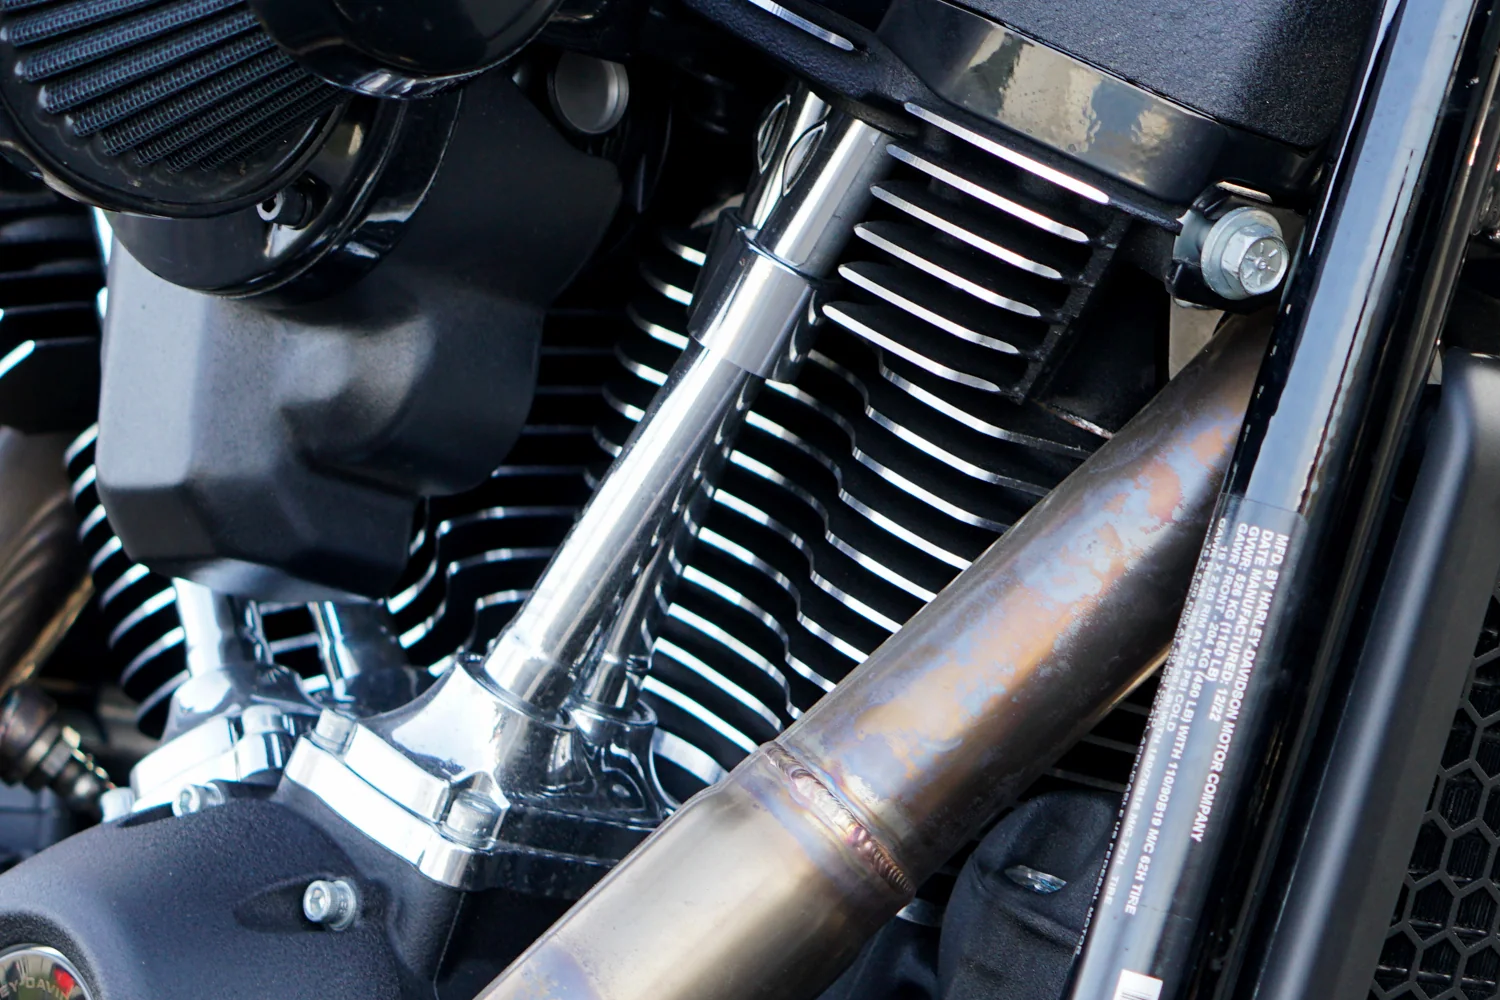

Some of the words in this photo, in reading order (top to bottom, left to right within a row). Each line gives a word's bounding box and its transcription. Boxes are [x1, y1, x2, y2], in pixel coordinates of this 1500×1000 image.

[1216, 544, 1228, 560] 19
[1228, 521, 1248, 565] GAWR
[1237, 524, 1260, 572] GVWR:
[1253, 528, 1274, 567] DATE
[1268, 533, 1289, 568] MFD.
[1213, 562, 1223, 572] X
[1262, 568, 1278, 589] BY
[1214, 566, 1236, 613] FRONT
[1230, 573, 1246, 598] 526
[1196, 603, 1211, 628] RIM
[1223, 598, 1239, 620] KG
[1190, 630, 1203, 649] AT
[1204, 621, 1219, 645] 204
[1212, 620, 1233, 657] (1160
[1219, 567, 1263, 686] MANUFACTURED:
[1197, 647, 1212, 669] KG
[1203, 657, 1222, 682] LB)
[1225, 589, 1272, 719] HARLEY-DAVIDSON
[1177, 669, 1191, 691] PSI
[1187, 669, 1205, 698] (450
[1165, 693, 1184, 732] COLD
[1179, 699, 1197, 723] LB)
[1208, 686, 1229, 722] 12/22
[1170, 723, 1189, 760] WITH
[1209, 720, 1235, 772] MOTOR
[1150, 760, 1179, 827] 110/90B19
[1189, 771, 1220, 842] COMPANY
[1142, 827, 1159, 854] M/C
[1134, 854, 1151, 881] 62H
[1103, 874, 1119, 905] TIRE
[1123, 882, 1143, 915] TIRE
